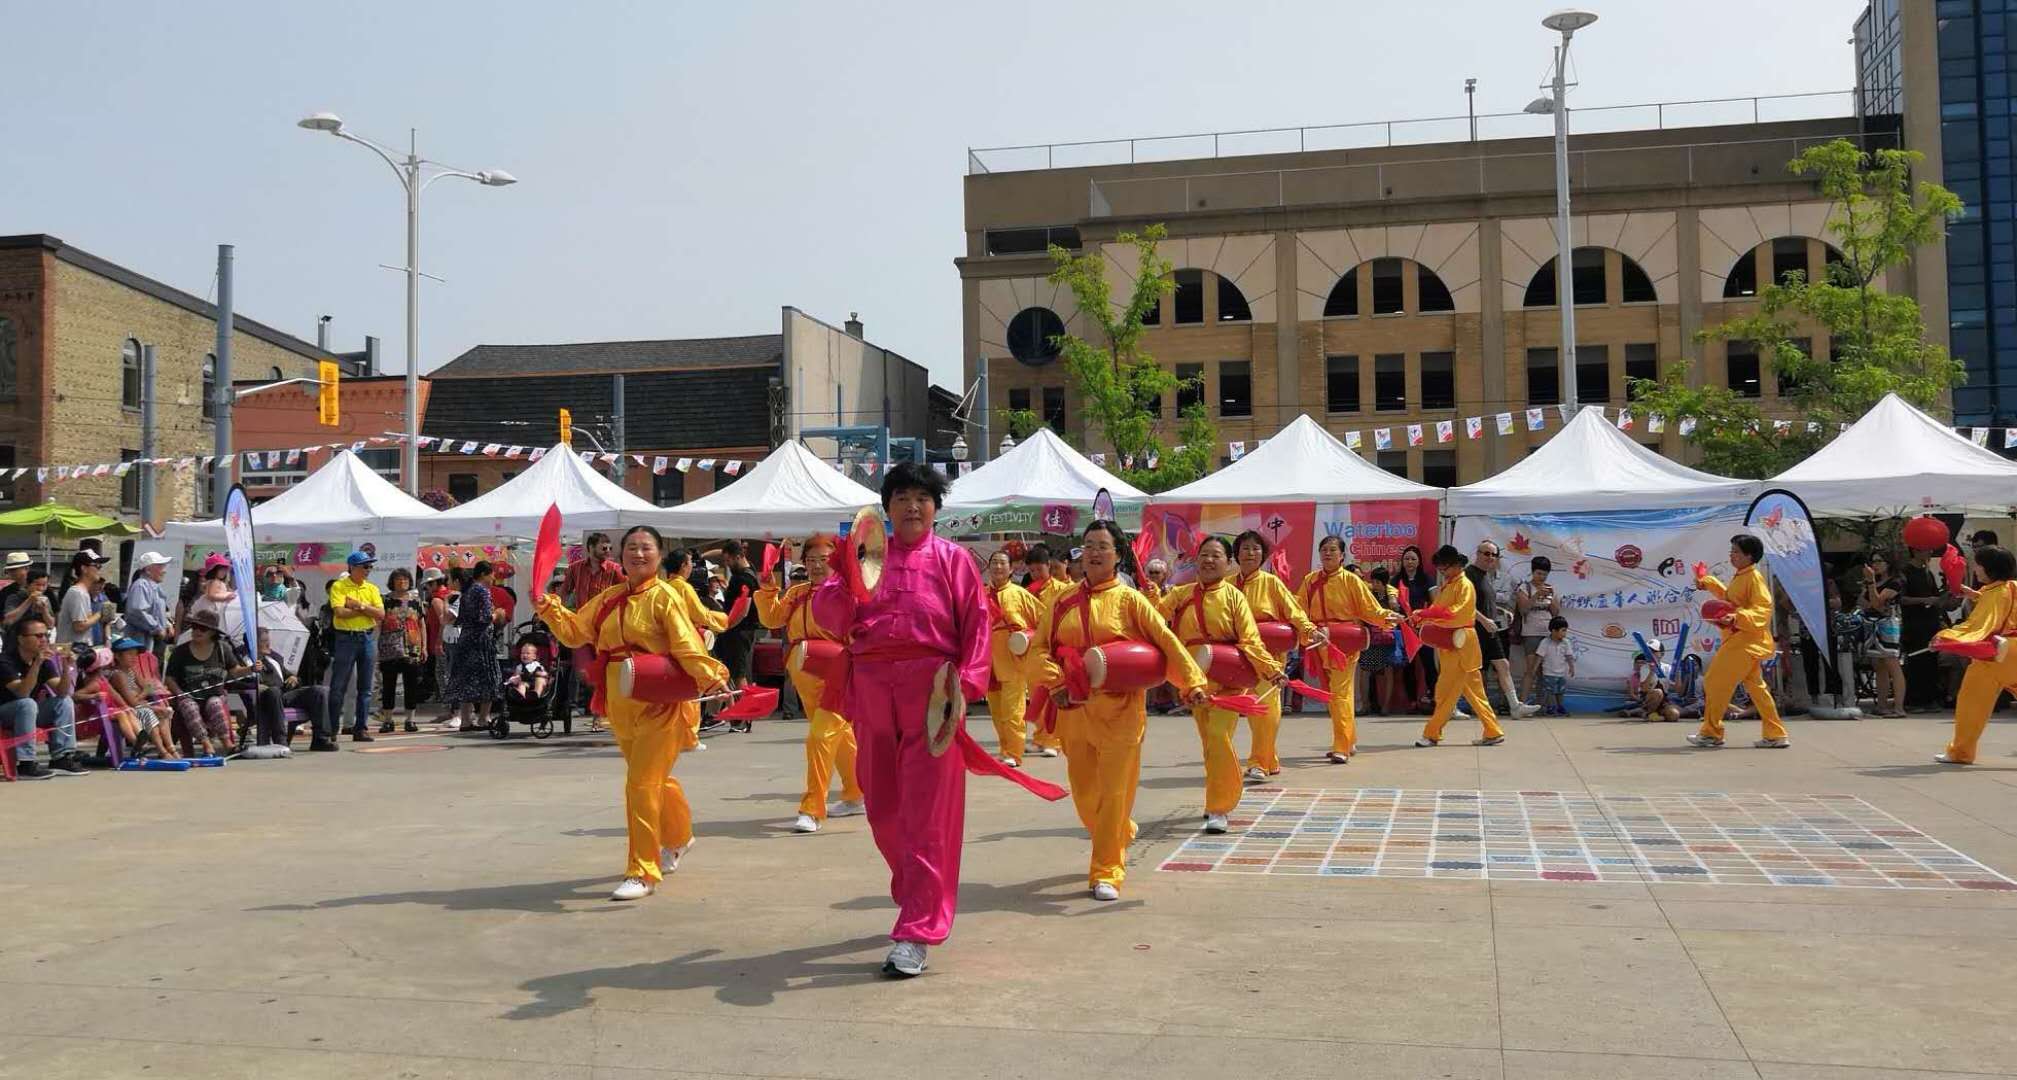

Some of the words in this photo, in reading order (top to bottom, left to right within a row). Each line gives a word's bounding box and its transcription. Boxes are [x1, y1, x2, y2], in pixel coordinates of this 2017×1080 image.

[989, 512, 1035, 525] FESTIVITY
[1267, 517, 1284, 544] 中
[1325, 520, 1417, 538] Waterloo
[256, 550, 292, 560] ESTIVITY
[1350, 542, 1406, 556] Chines
